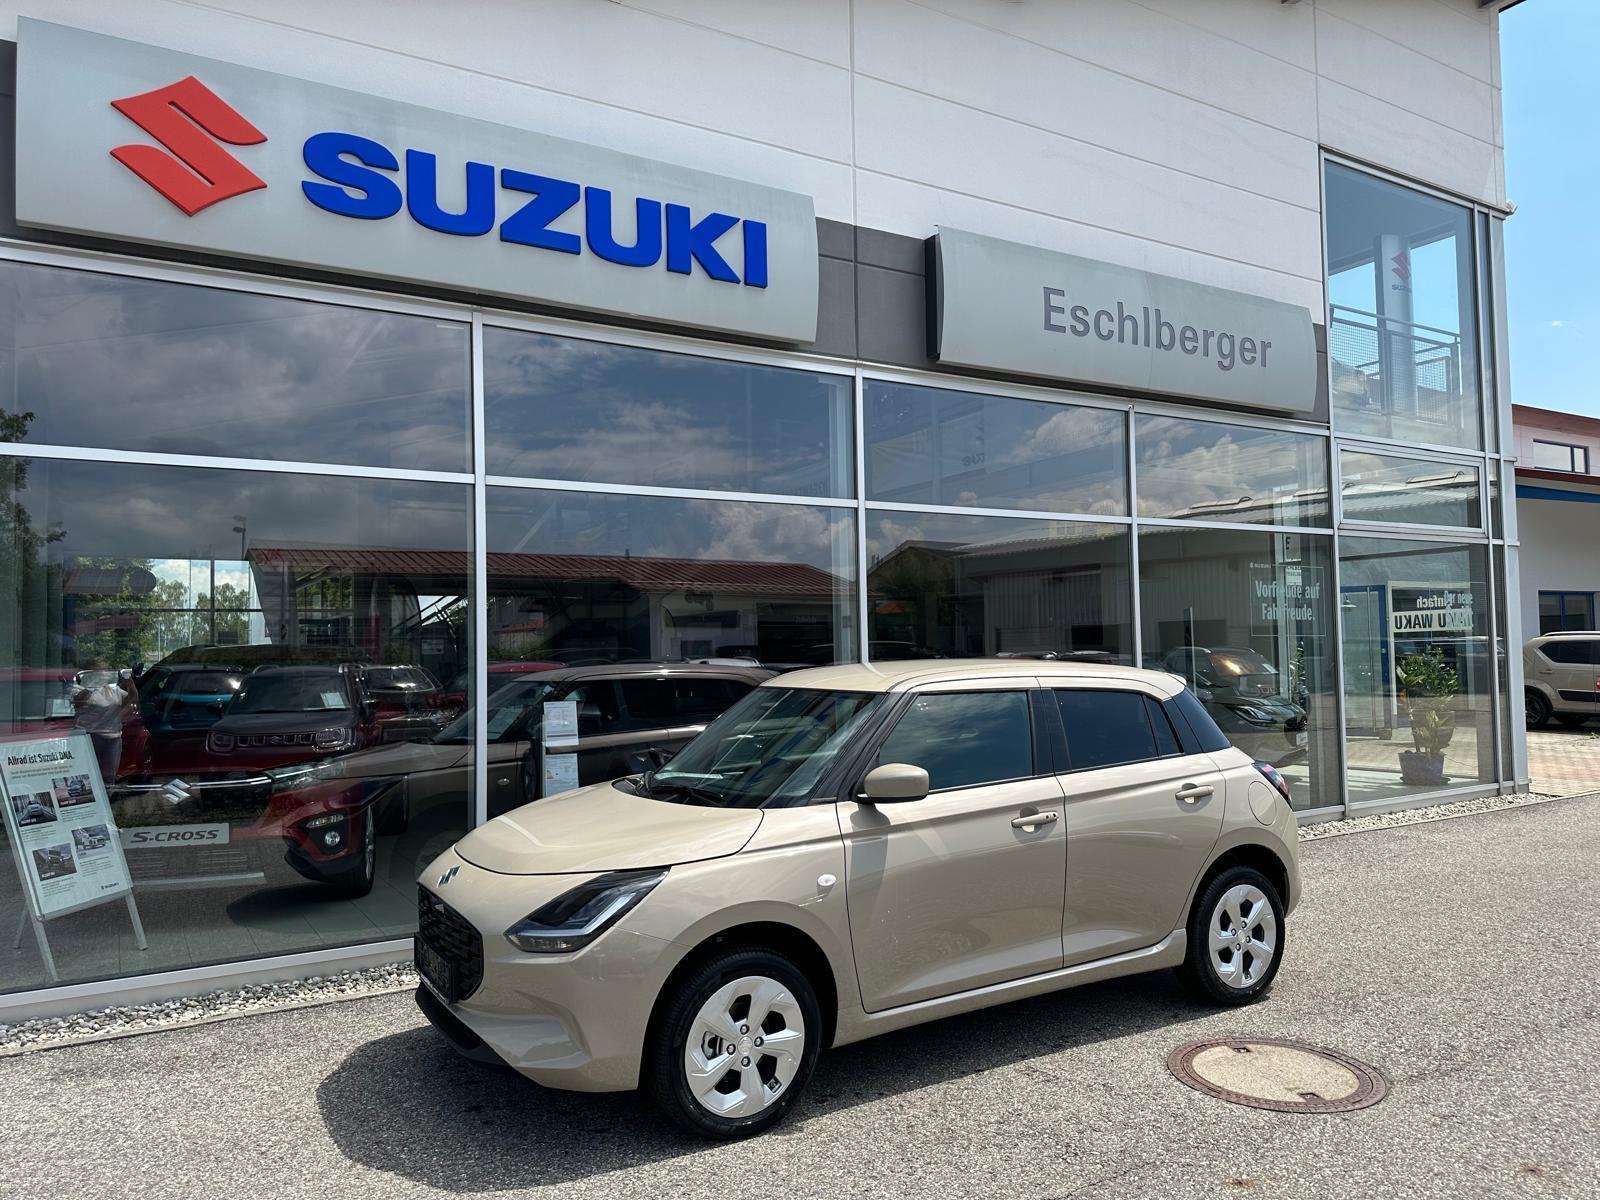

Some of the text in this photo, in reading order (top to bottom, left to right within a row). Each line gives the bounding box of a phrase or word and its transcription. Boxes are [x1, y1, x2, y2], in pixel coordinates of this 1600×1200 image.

[301, 131, 768, 288] SUZUKI
[1043, 286, 1272, 371] Eschlberger
[1304, 583, 1320, 599] auf
[7, 750, 75, 766] Allrad ist Suzuki DNA.
[130, 829, 219, 843] S-CROSS
